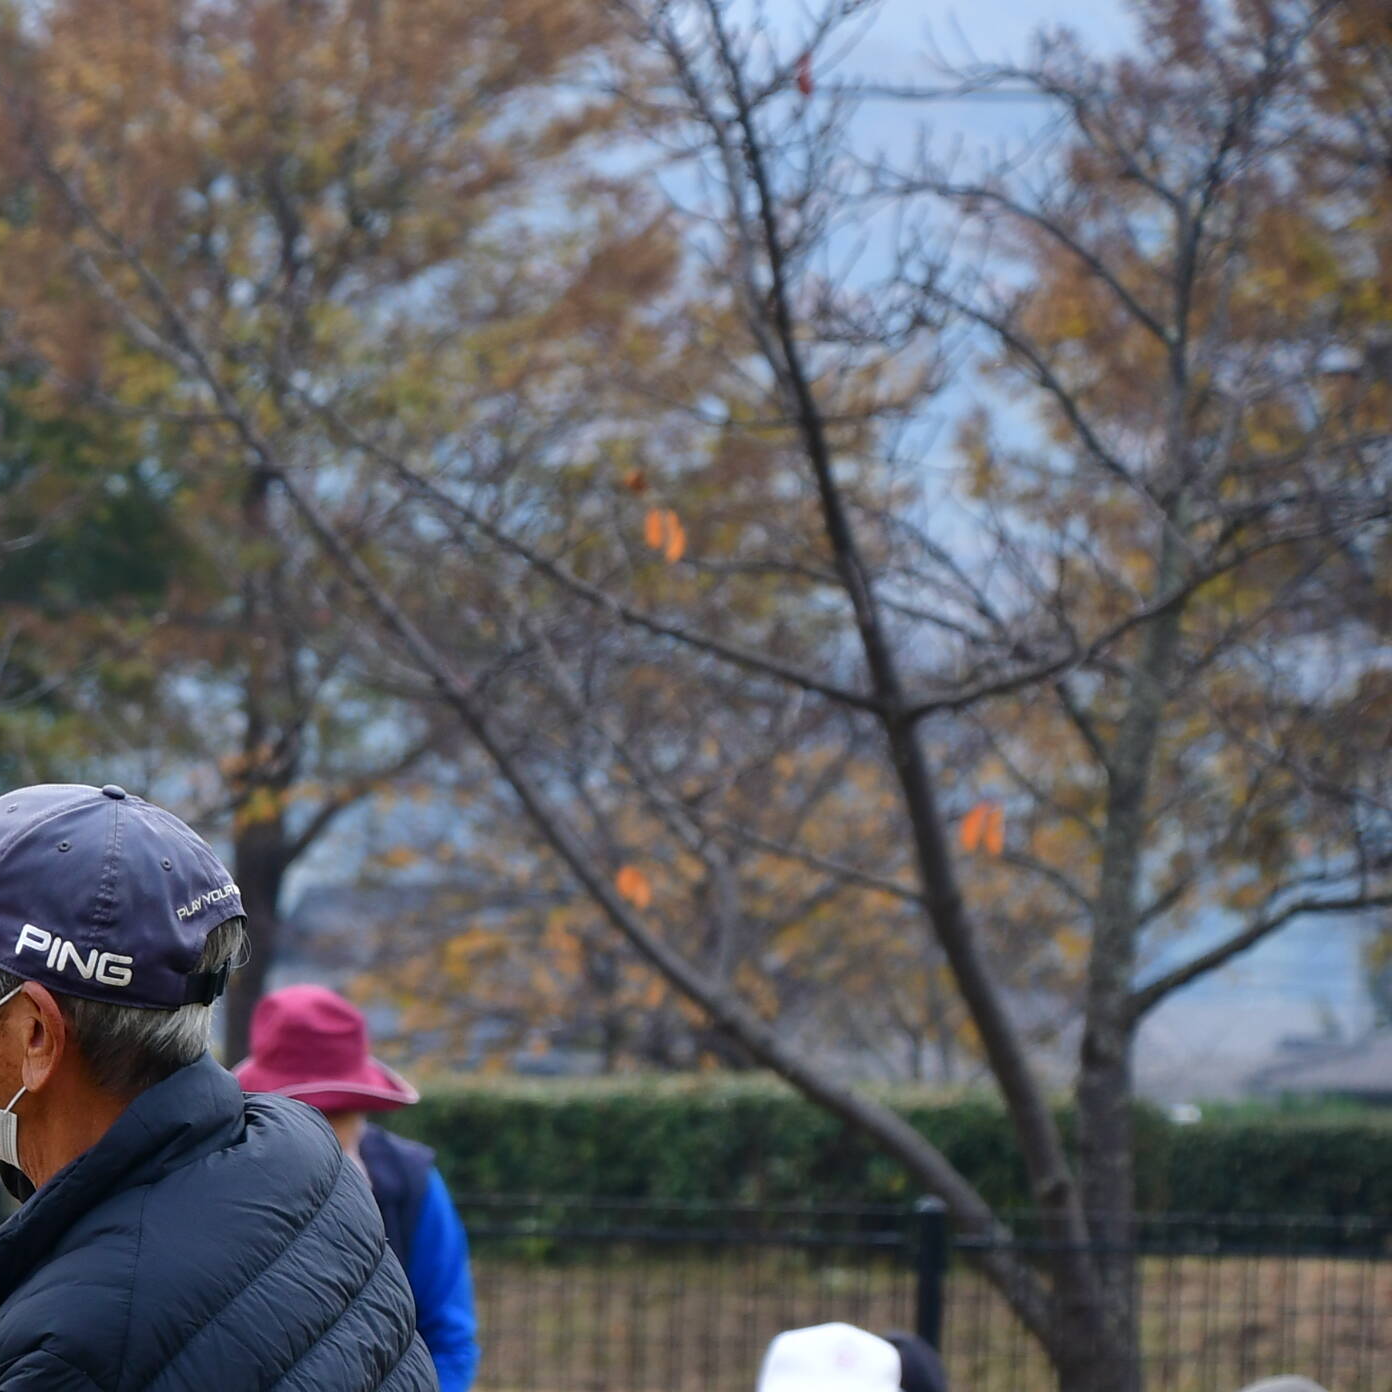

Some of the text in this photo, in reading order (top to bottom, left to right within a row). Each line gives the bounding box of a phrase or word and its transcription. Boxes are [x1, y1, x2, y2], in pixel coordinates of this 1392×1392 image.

[176, 897, 202, 921] PLAY
[202, 884, 234, 905] YOUR
[14, 923, 134, 988] PING
